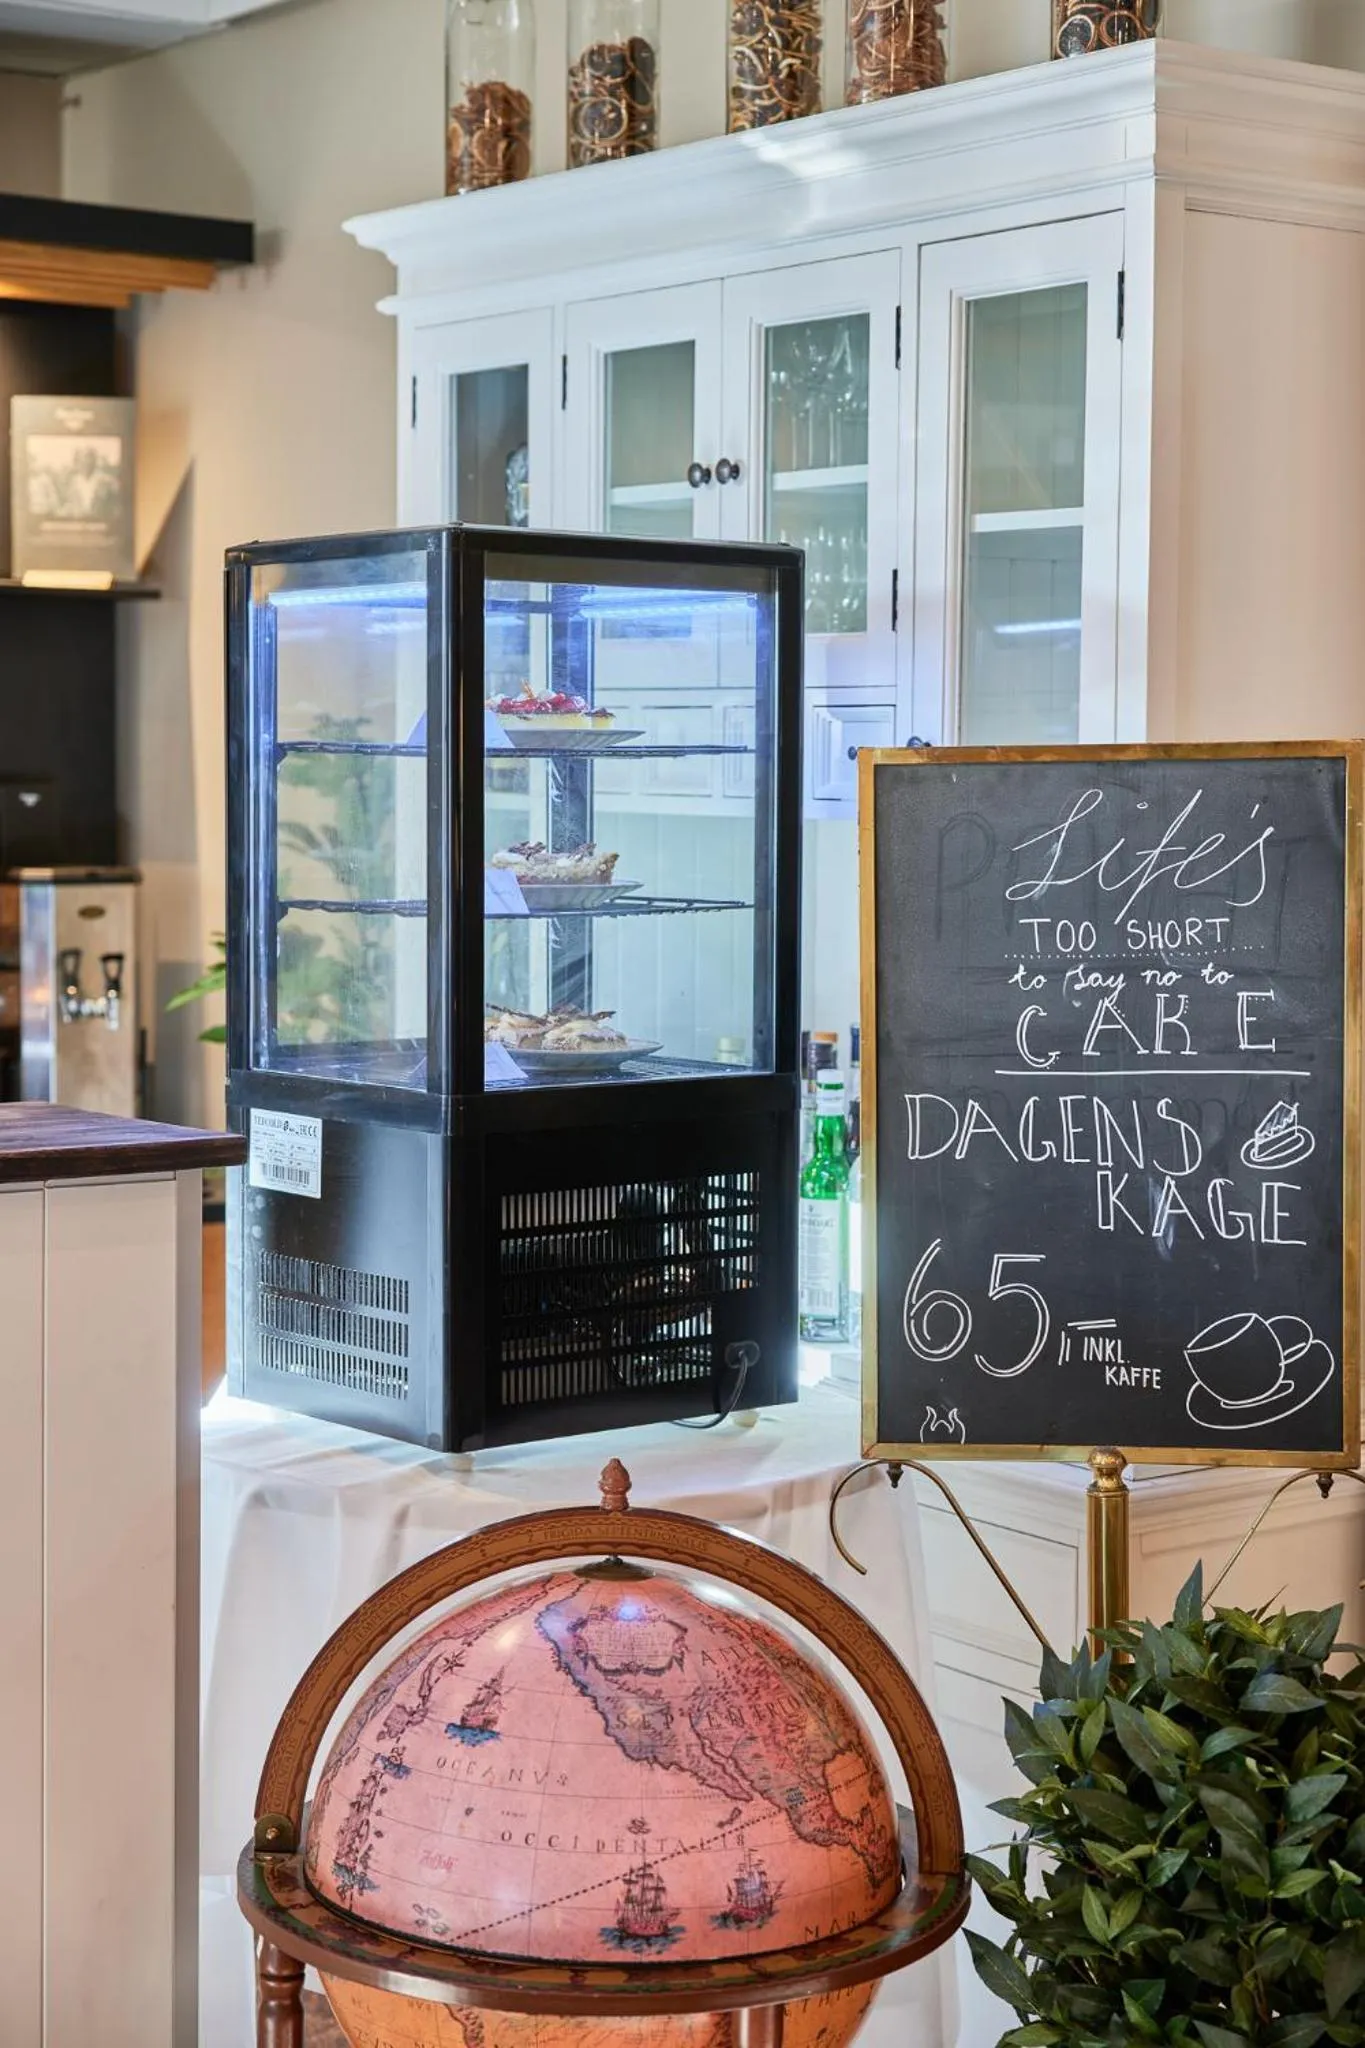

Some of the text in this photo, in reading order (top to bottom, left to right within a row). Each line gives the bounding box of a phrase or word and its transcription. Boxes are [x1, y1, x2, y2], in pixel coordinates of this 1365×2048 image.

[1005, 788, 1275, 924] Life's
[1019, 917, 1231, 953] TOO SHORT
[1009, 963, 1047, 991] to
[1141, 971, 1183, 988] no
[1201, 962, 1234, 985] to
[1016, 989, 1276, 1069] CAKE
[904, 1093, 1202, 1176] DAGENS
[1097, 1171, 1307, 1246] KAGE
[1105, 1366, 1162, 1390] KAFFE
